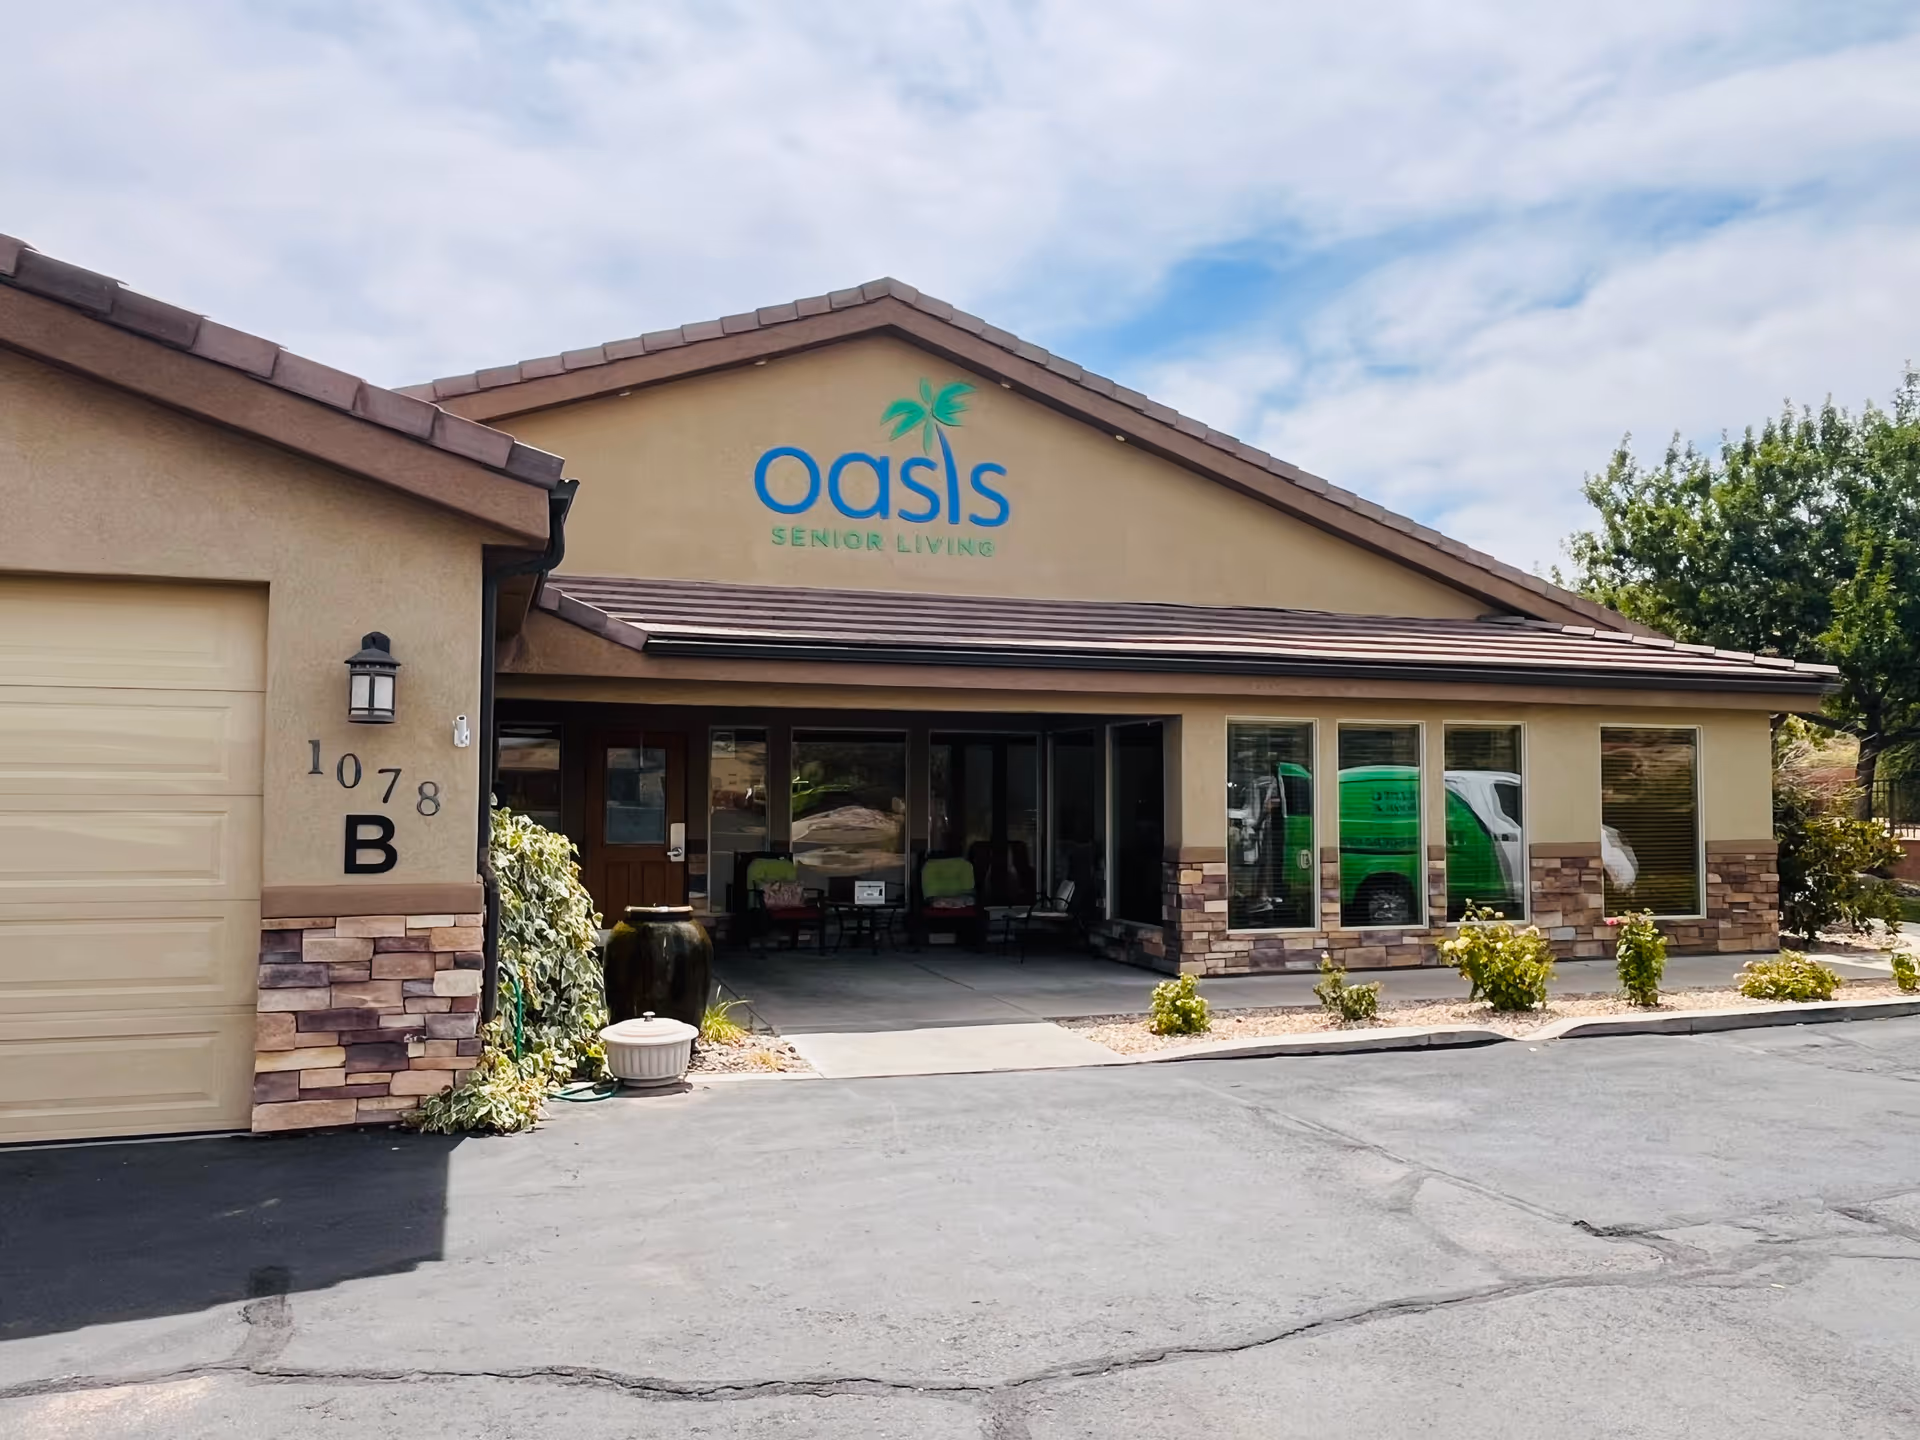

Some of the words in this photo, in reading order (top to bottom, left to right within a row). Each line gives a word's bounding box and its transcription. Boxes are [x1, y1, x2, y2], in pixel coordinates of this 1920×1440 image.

[771, 525, 883, 551] SENIOR
[897, 534, 996, 557] LIVING
[308, 739, 441, 817] 1078
[344, 814, 398, 874] B
